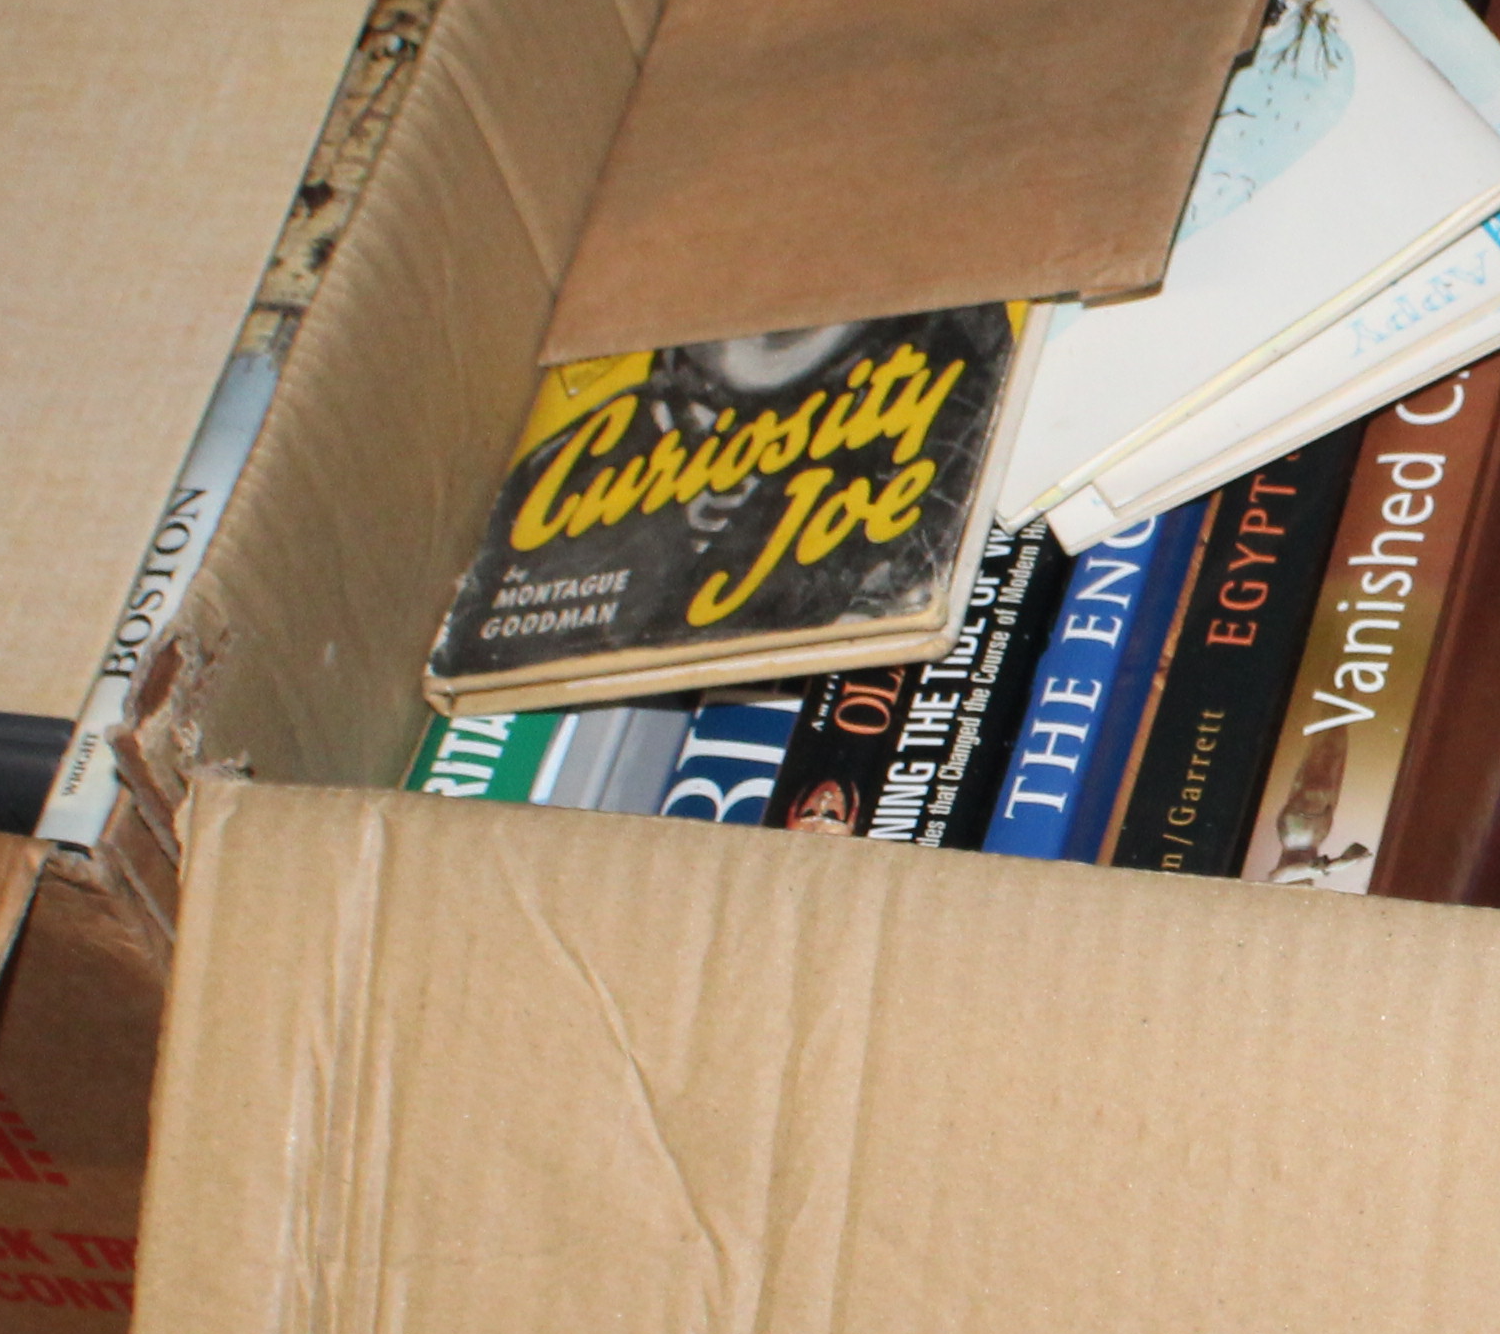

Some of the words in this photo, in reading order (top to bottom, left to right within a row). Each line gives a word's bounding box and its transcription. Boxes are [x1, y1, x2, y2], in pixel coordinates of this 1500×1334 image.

[509, 342, 965, 552] Curiosity
[685, 458, 936, 627] Joe
[1206, 451, 1301, 648] EGYPT
[103, 486, 207, 679] BOSTON
[492, 568, 632, 608] MONTAGUE
[998, 545, 1040, 605] Modern
[1301, 451, 1447, 737] Vanished
[480, 601, 620, 641] GOODMAN
[994, 606, 1017, 626] of
[969, 629, 1011, 683] Course
[896, 691, 961, 753] THE
[962, 687, 992, 713] the
[936, 716, 982, 780] Changed
[1003, 675, 1104, 821] THE
[927, 779, 960, 817] that
